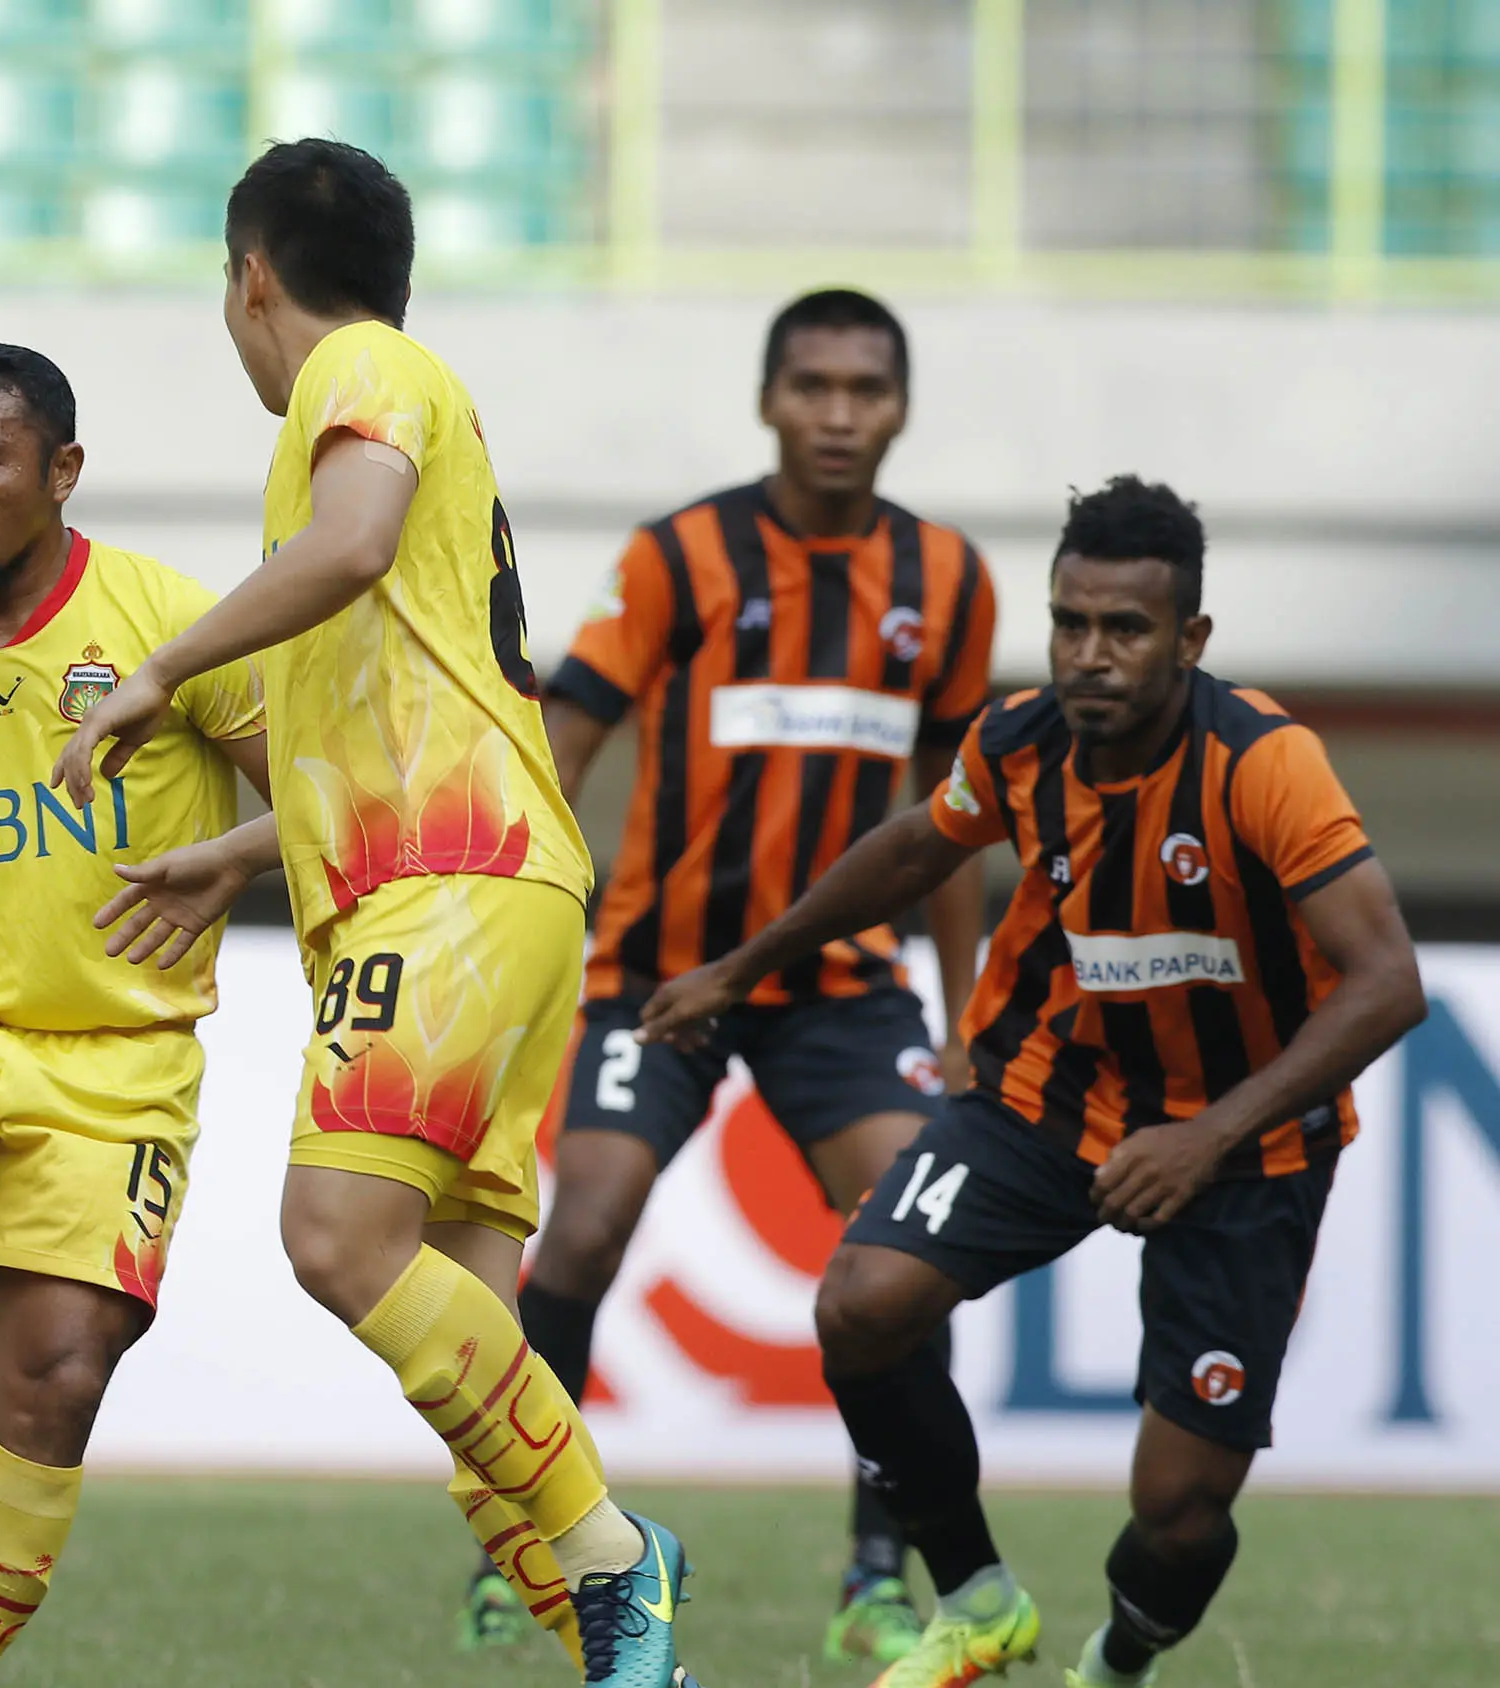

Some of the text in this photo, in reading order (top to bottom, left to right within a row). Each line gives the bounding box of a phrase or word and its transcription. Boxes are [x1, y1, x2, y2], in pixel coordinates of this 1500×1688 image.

[316, 953, 404, 1036] 89
[1073, 952, 1236, 984] BANK PAPUA
[595, 1028, 643, 1113] 2
[126, 1142, 173, 1223] 15
[891, 1151, 970, 1235] 14
